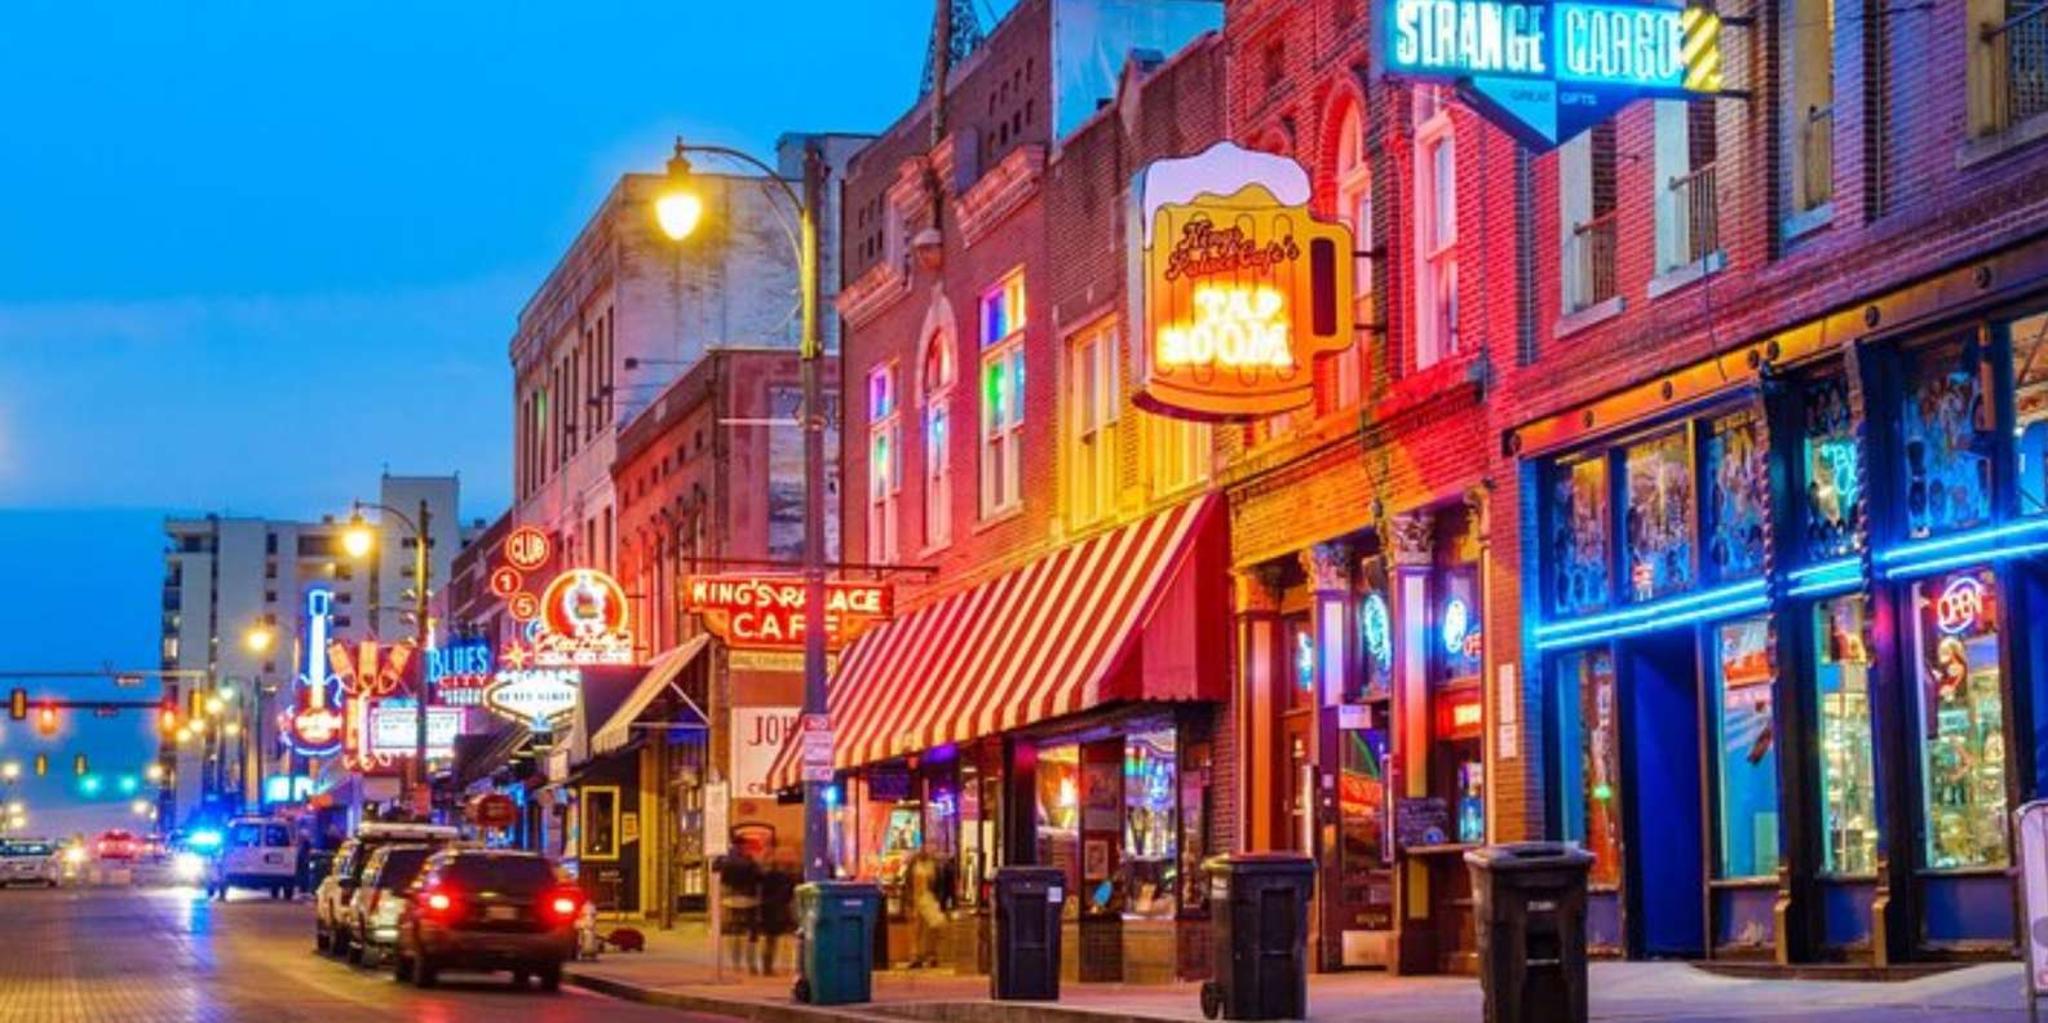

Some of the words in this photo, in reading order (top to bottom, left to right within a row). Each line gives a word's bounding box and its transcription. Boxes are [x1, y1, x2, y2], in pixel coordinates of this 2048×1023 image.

[1395, 1, 1546, 73] STRANGE
[1566, 7, 1682, 78] CARGO
[1560, 91, 1597, 107] GIFTS
[1194, 286, 1283, 325] TAP
[1160, 321, 1293, 367] ROOM
[513, 534, 545, 564] CLUB
[500, 574, 512, 592] 1
[692, 580, 776, 608] KING'S
[517, 598, 532, 617] 5
[1937, 592, 1984, 623] OPEN
[427, 646, 488, 683] BLUES
[439, 675, 487, 688] CITY
